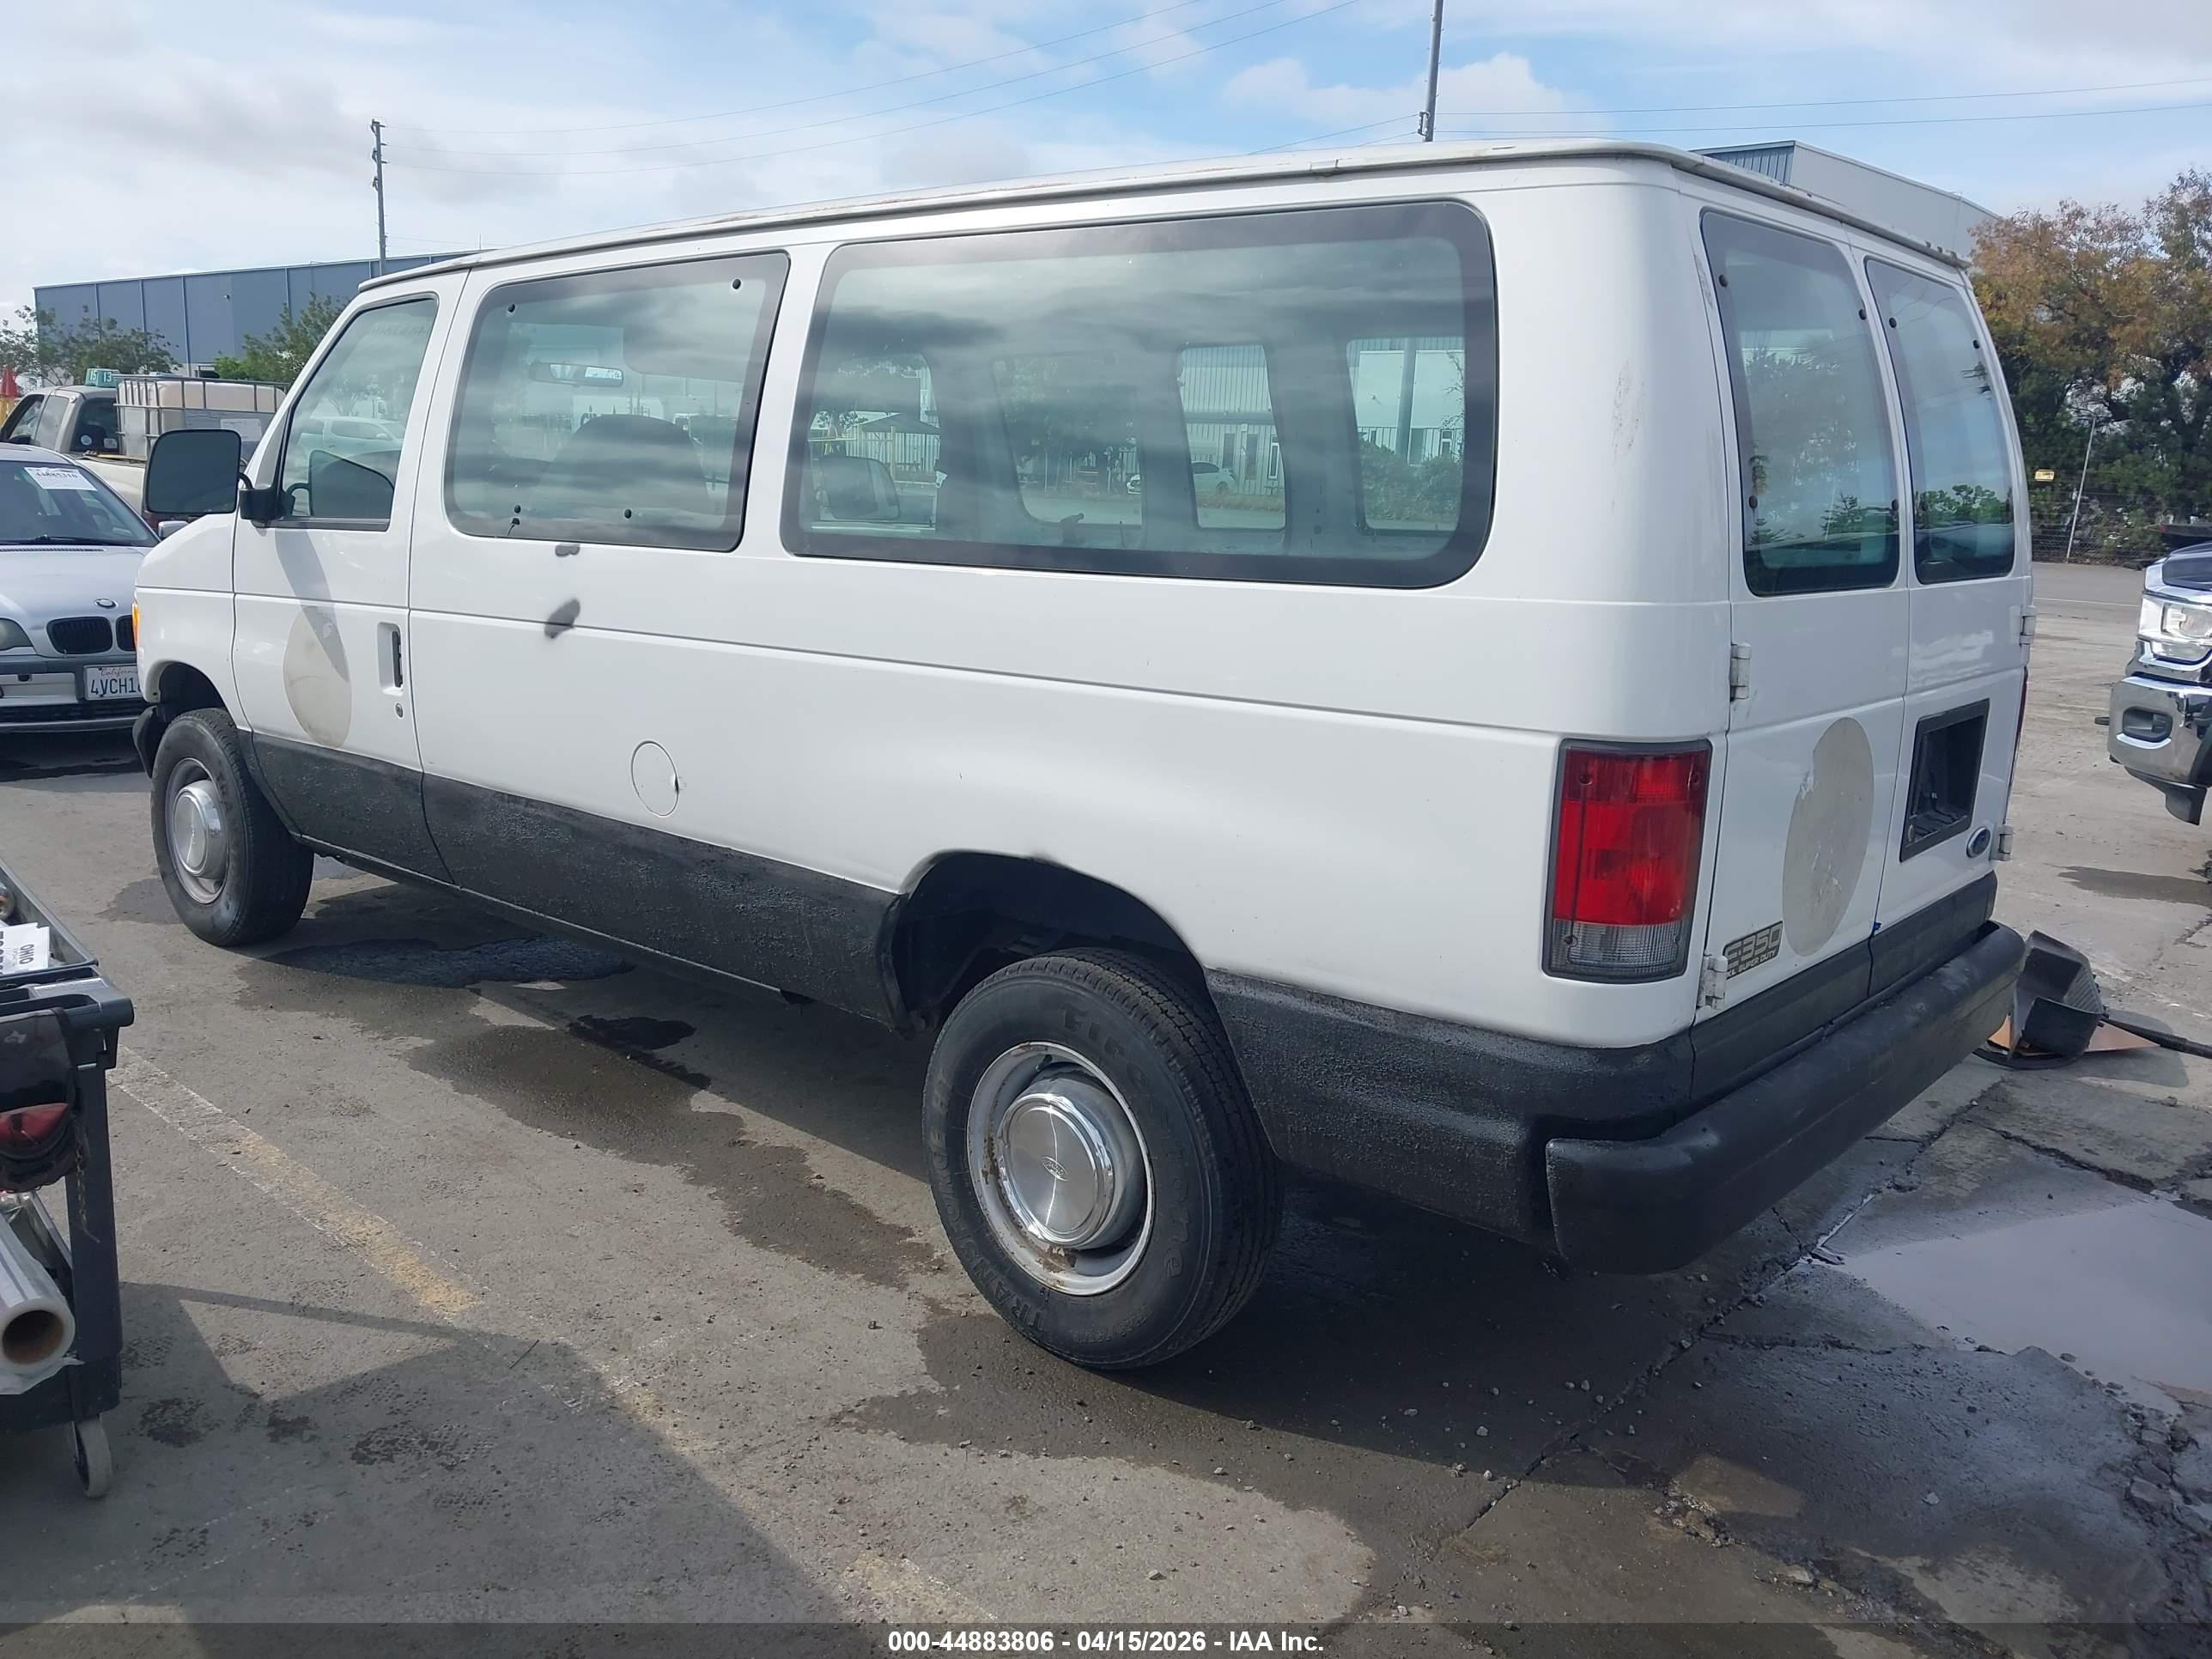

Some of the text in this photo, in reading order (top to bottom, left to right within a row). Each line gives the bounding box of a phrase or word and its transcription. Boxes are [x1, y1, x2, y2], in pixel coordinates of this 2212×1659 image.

[90, 370, 97, 380] 15
[103, 372, 112, 381] 13
[91, 678, 142, 696] 4VCH1
[19, 944, 34, 964] OHIO
[1739, 958, 1759, 972] SUPER
[1760, 949, 1777, 962] DUTY
